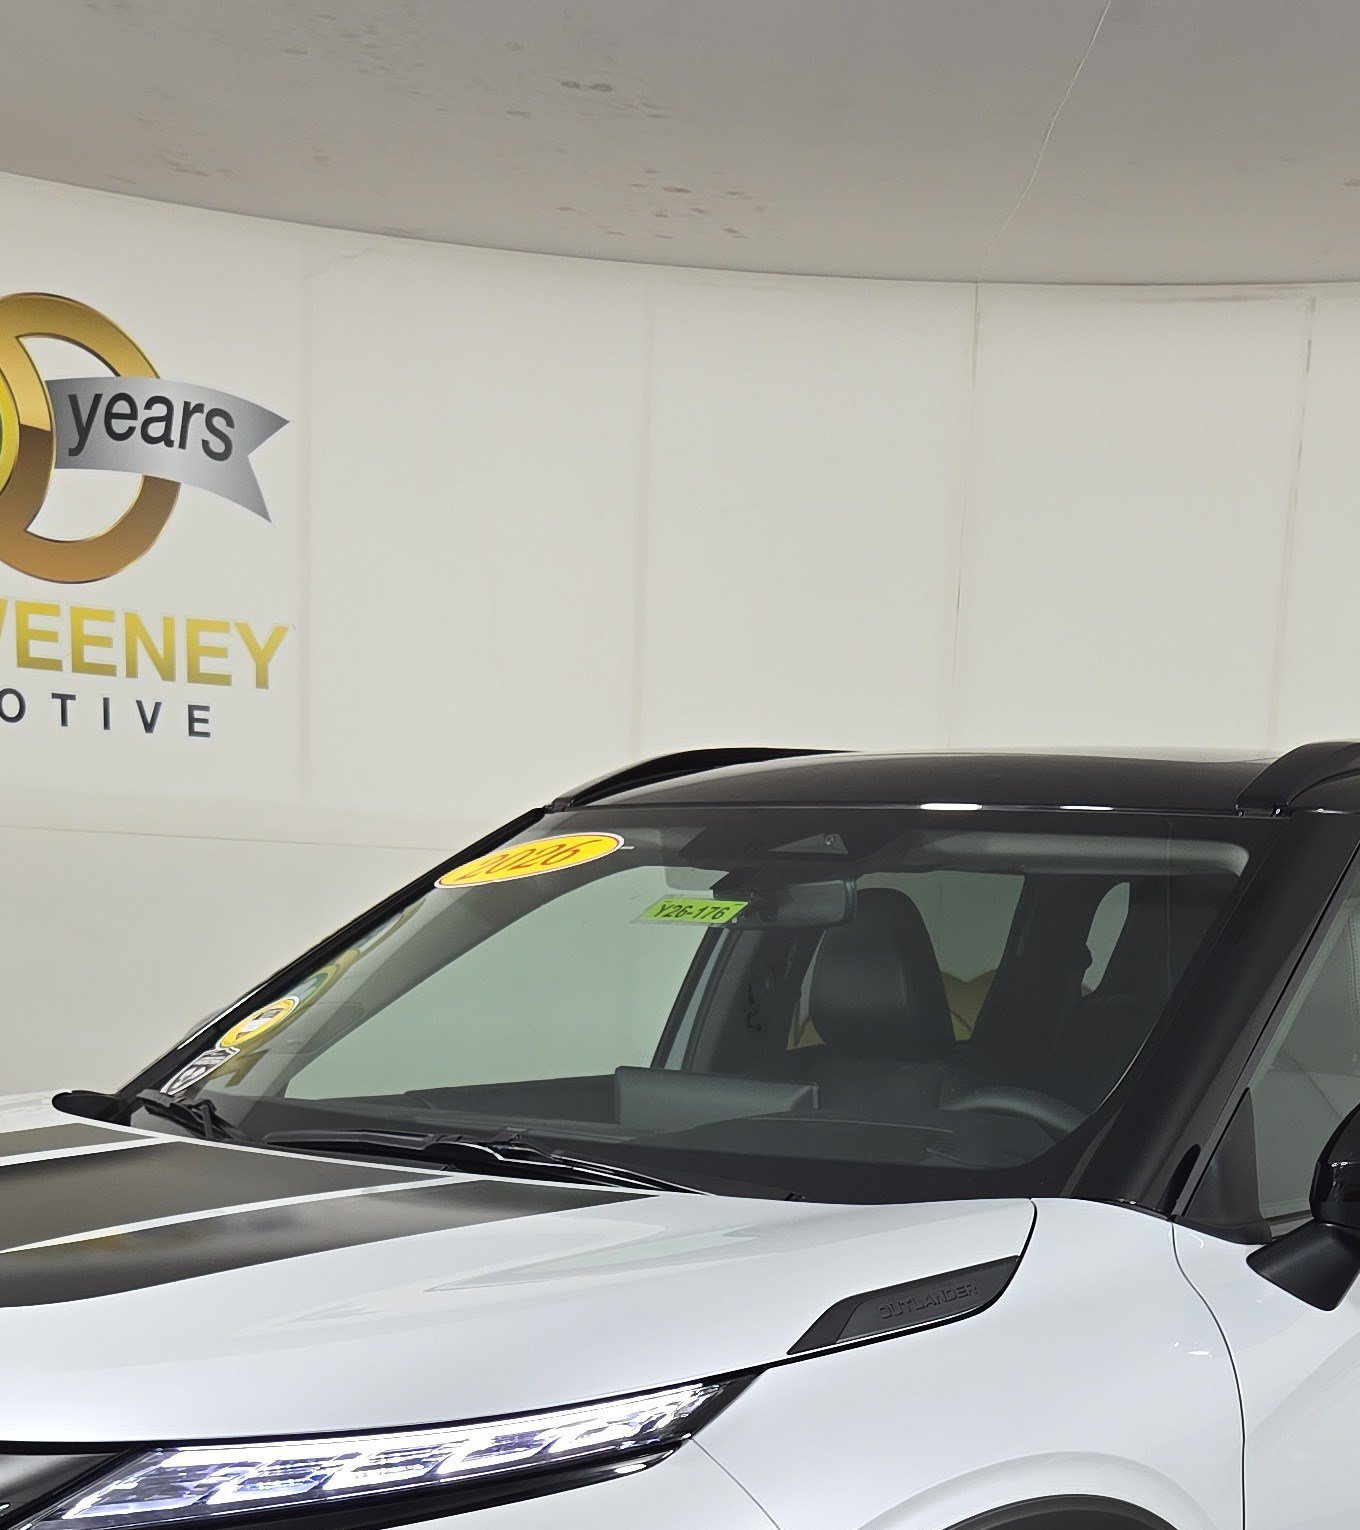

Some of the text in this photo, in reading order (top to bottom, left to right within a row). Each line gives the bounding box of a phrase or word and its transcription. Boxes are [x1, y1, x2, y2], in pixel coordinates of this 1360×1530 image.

[67, 391, 235, 462] years
[452, 838, 603, 882] 2026
[653, 904, 731, 920] Y26-176
[878, 1282, 980, 1320] OUTLANDER
